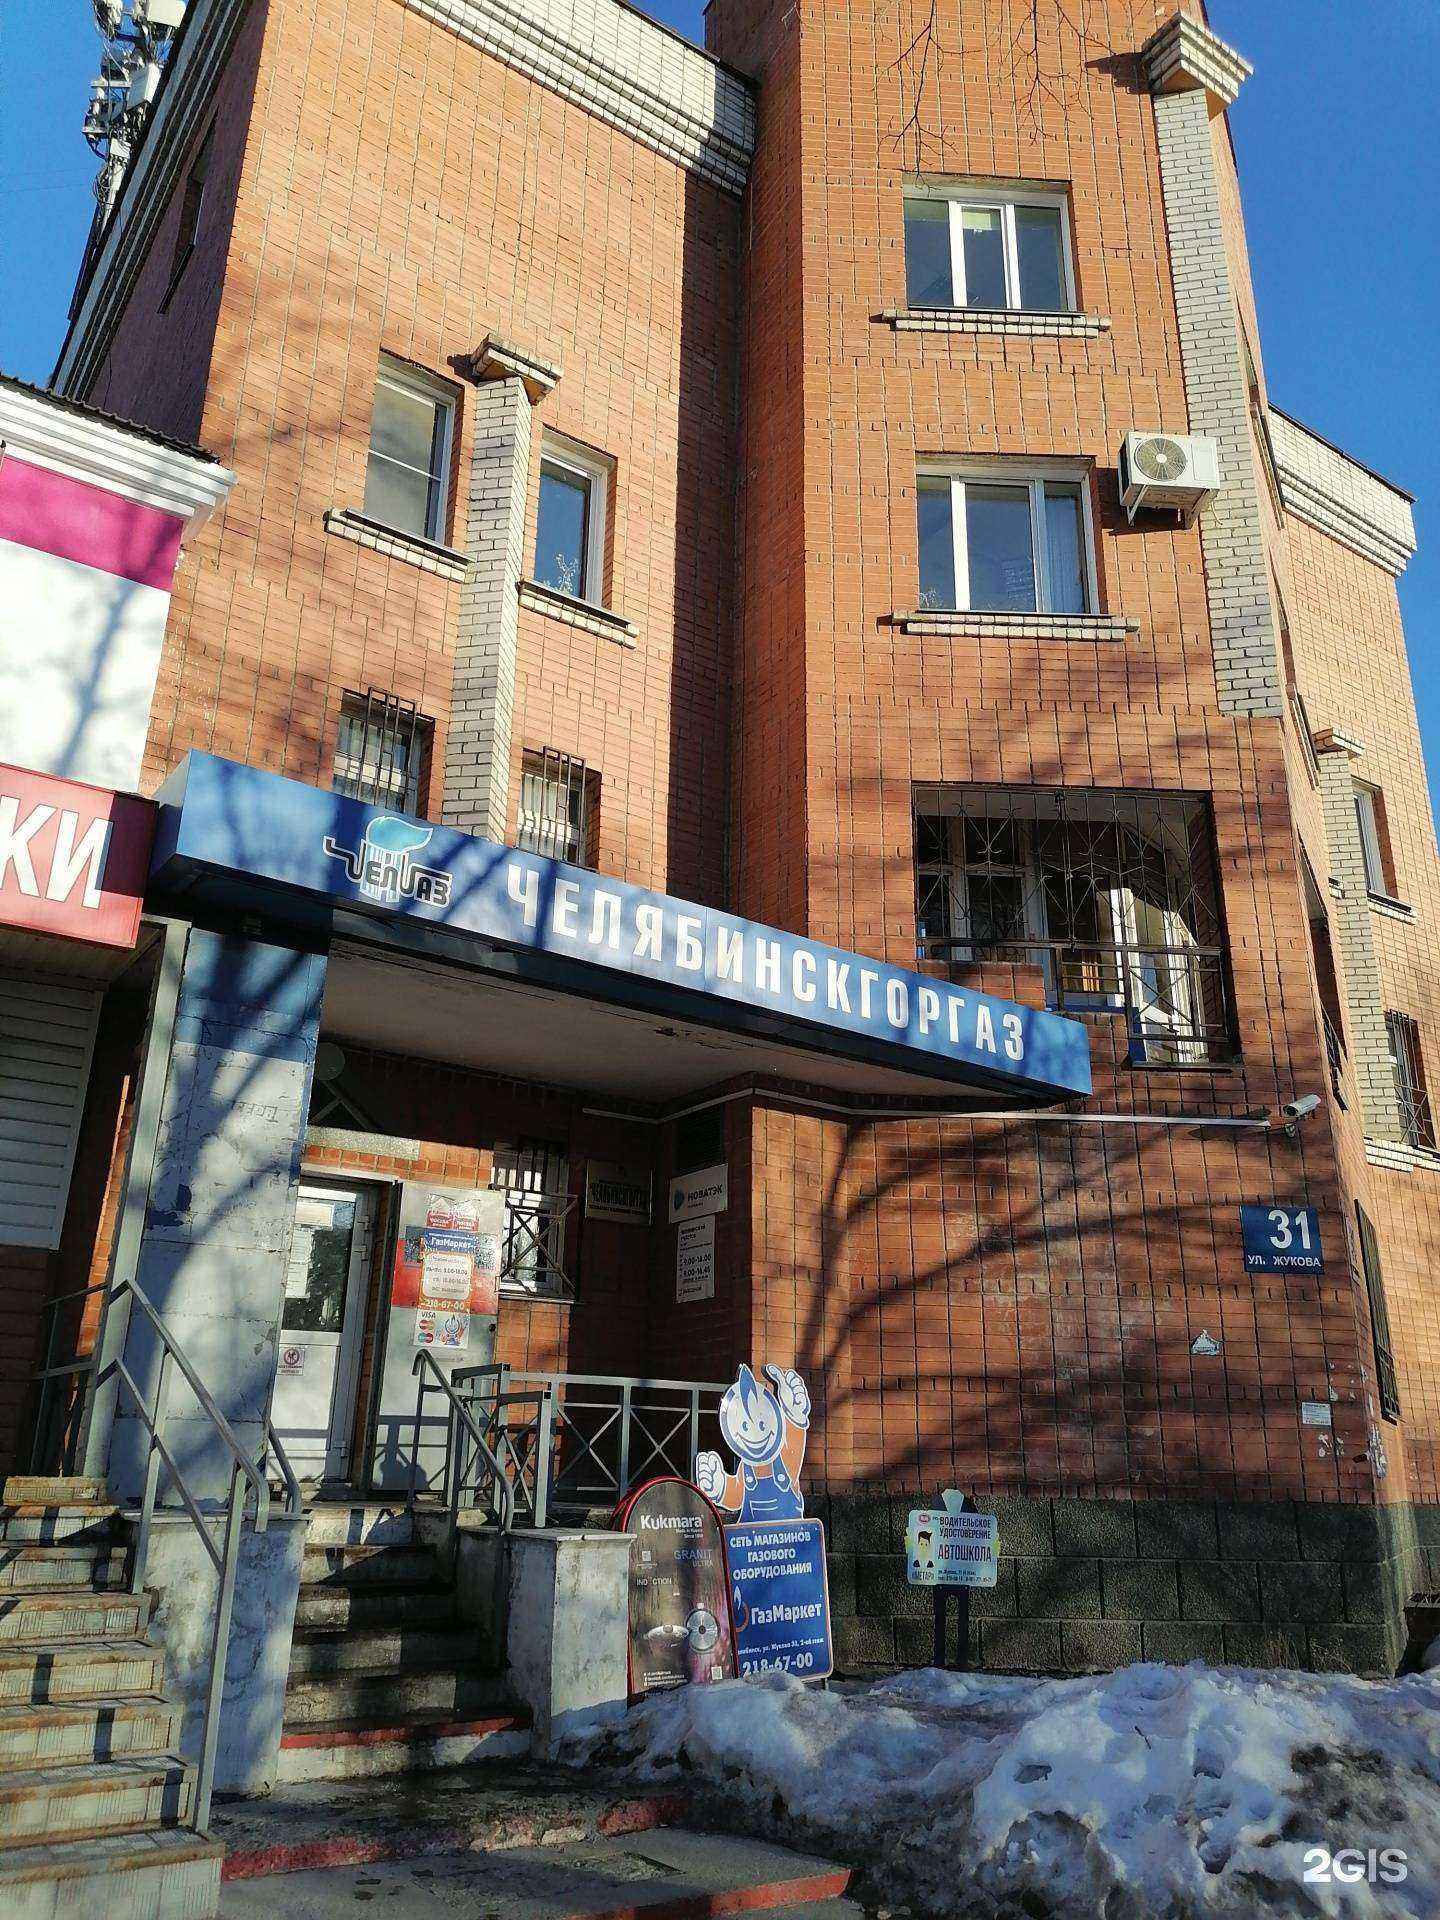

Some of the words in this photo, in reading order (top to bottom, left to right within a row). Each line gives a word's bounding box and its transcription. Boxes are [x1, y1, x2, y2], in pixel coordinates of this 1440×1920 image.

[0, 795, 114, 909] КИ
[506, 863, 1025, 1062] ЧЕЛЯБИНСКГОРГАЗ
[687, 1184, 723, 1202] НОВАТЭК
[1268, 1209, 1311, 1249] 31
[1248, 1255, 1266, 1265] УЛ.
[1273, 1256, 1321, 1267] ЖУКОВА
[421, 1311, 436, 1319] VISA
[640, 1514, 703, 1529] Kukmara
[939, 1516, 991, 1529] ВОДИТЕЛЬСКОЕ
[729, 1536, 752, 1548] СЕТЬ
[753, 1531, 811, 1546] МАГАЗИНОВ
[939, 1527, 991, 1540] УДОСТОВЕРЕНИЕ
[673, 1549, 713, 1560] GRANIT
[747, 1548, 796, 1563] ГАЗОВОГО
[938, 1543, 992, 1562] АВТОШКОЛА
[732, 1562, 812, 1580] ОБОРУДОВАНИЯ
[636, 1577, 672, 1586] INDCTION
[751, 1603, 822, 1625] ГазМаркет
[742, 1651, 814, 1678] 218-67-00
